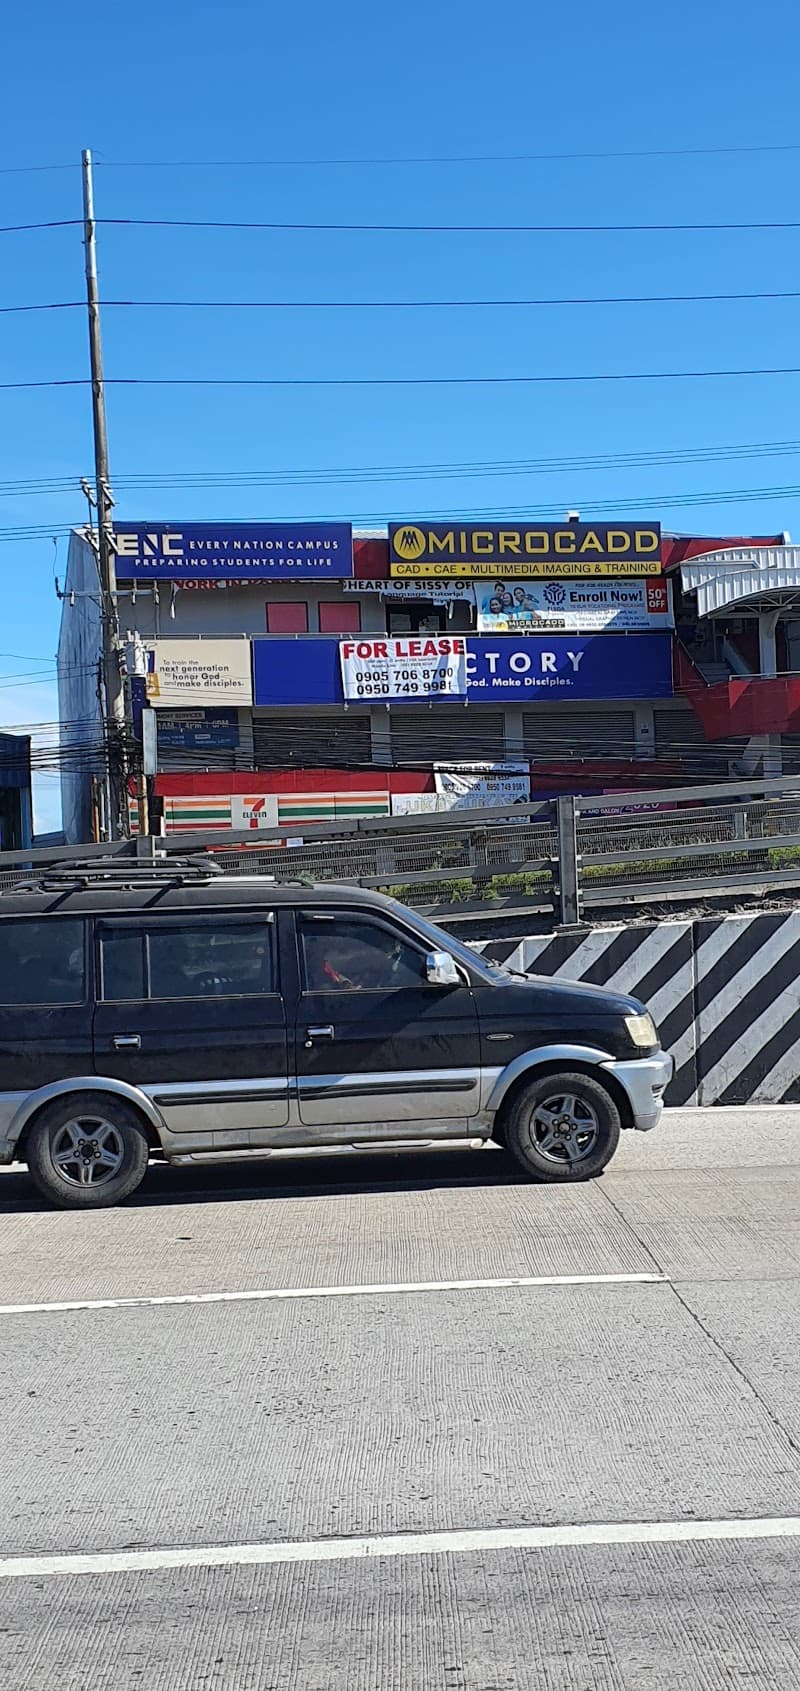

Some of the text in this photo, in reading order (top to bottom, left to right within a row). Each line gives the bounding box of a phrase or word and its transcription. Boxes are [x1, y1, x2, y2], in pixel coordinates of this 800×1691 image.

[117, 533, 184, 556] ENC
[189, 540, 339, 550] EVERY NATION CAMPUS
[428, 530, 659, 554] MICROCADD
[134, 558, 332, 566] PREPARING STUDENTS FOR LIFE
[396, 562, 657, 575] CAD CAE MULTIMEDIA IMAGING & TRAINING
[393, 580, 411, 590] OF
[415, 580, 449, 590] SISSY
[569, 589, 644, 603] Enroll Now!
[648, 600, 666, 608] OFF
[342, 639, 466, 659] FOR LEASE
[181, 664, 229, 673] generation
[356, 667, 454, 682] 0905 706 8700
[201, 672, 220, 680] God
[492, 677, 521, 687] Make
[524, 676, 574, 688] Disciples.
[204, 679, 244, 688] disciples.
[357, 681, 452, 695] 0950 749 9981
